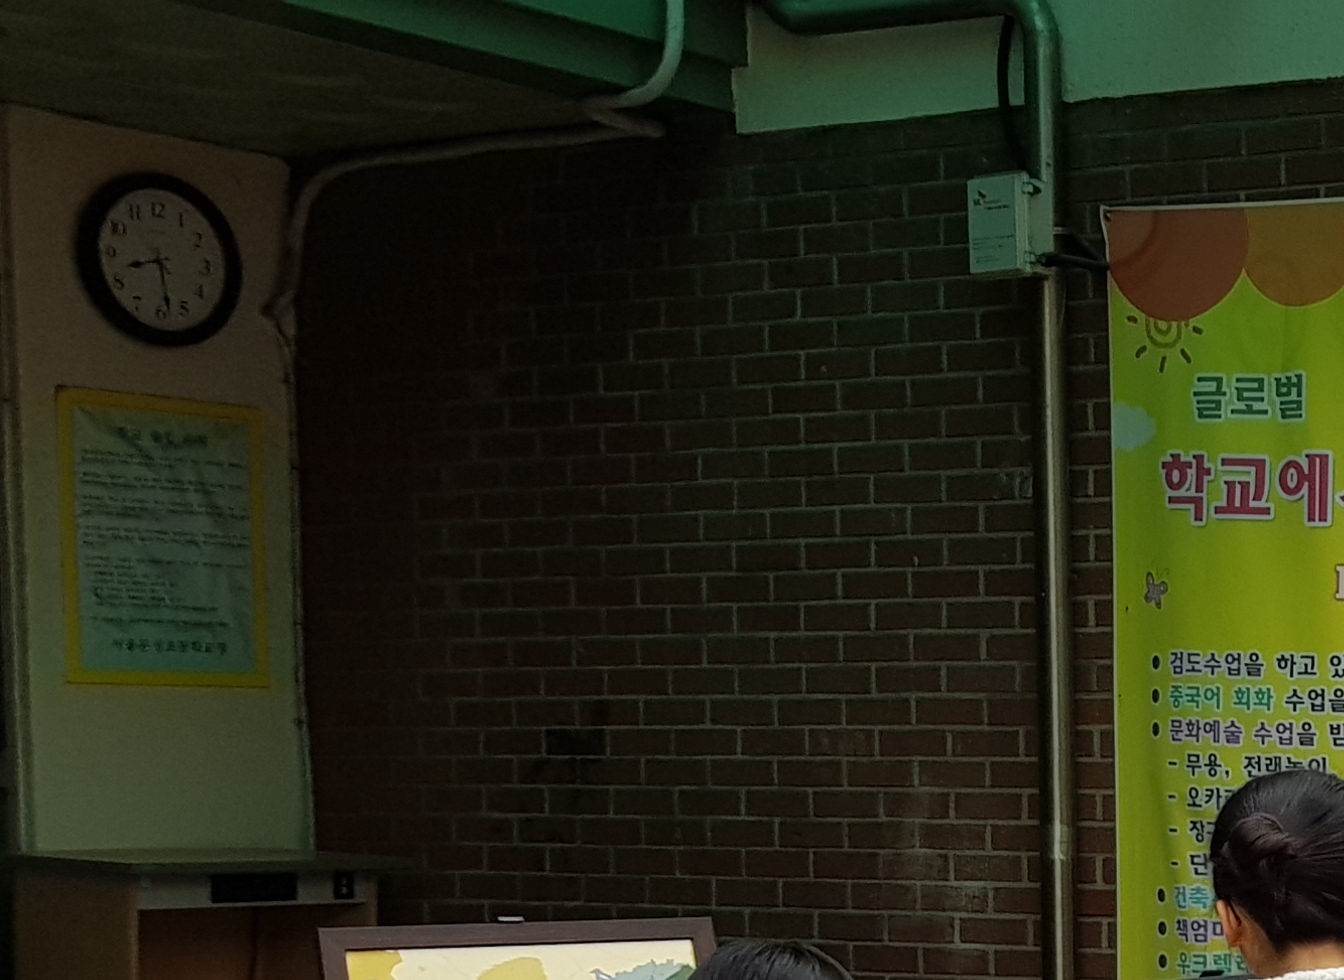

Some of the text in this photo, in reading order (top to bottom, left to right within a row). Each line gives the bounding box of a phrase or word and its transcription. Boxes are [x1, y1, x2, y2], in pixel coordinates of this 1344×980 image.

[1192, 372, 1305, 420] 글로벌
[1169, 651, 1265, 678] 검도수업을
[1275, 653, 1318, 678] 하고
[1169, 684, 1221, 710] 중국어
[1233, 686, 1274, 711] 회화
[1169, 718, 1244, 745] 문화예술
[1253, 721, 1318, 747] 수업을
[1185, 752, 1231, 779] 무용,
